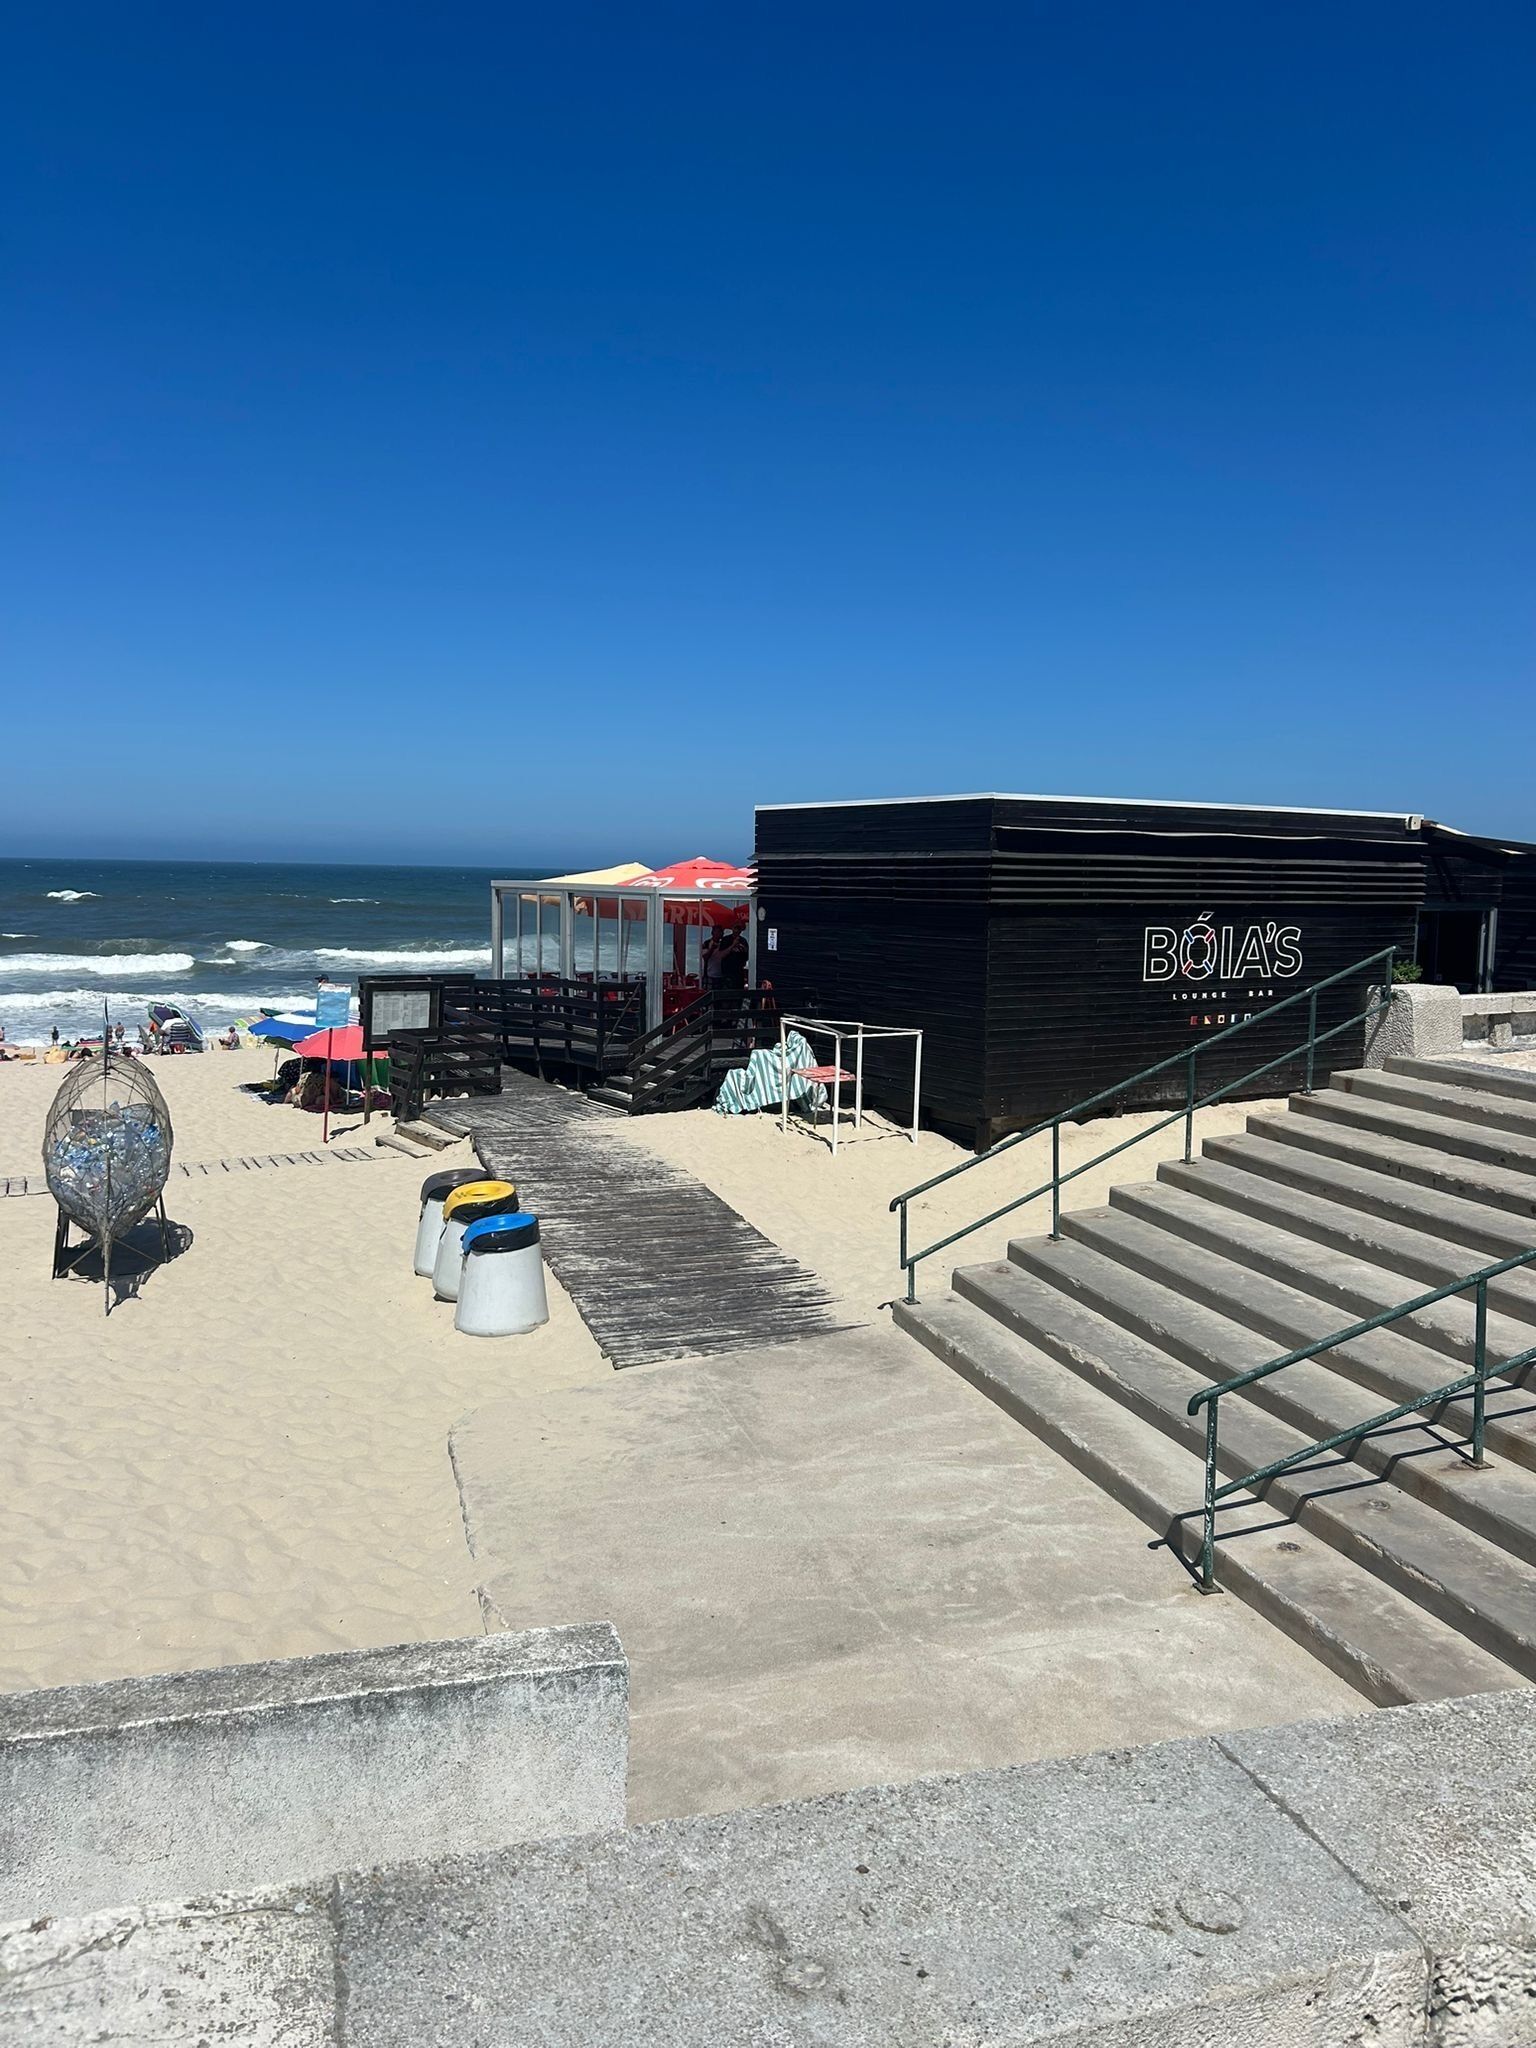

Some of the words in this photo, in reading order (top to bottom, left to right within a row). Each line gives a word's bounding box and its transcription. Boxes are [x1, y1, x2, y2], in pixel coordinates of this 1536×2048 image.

[1143, 911, 1303, 982] BÓIA'S
[1172, 991, 1227, 1001] LOUNGE
[1248, 989, 1273, 997] BAR
